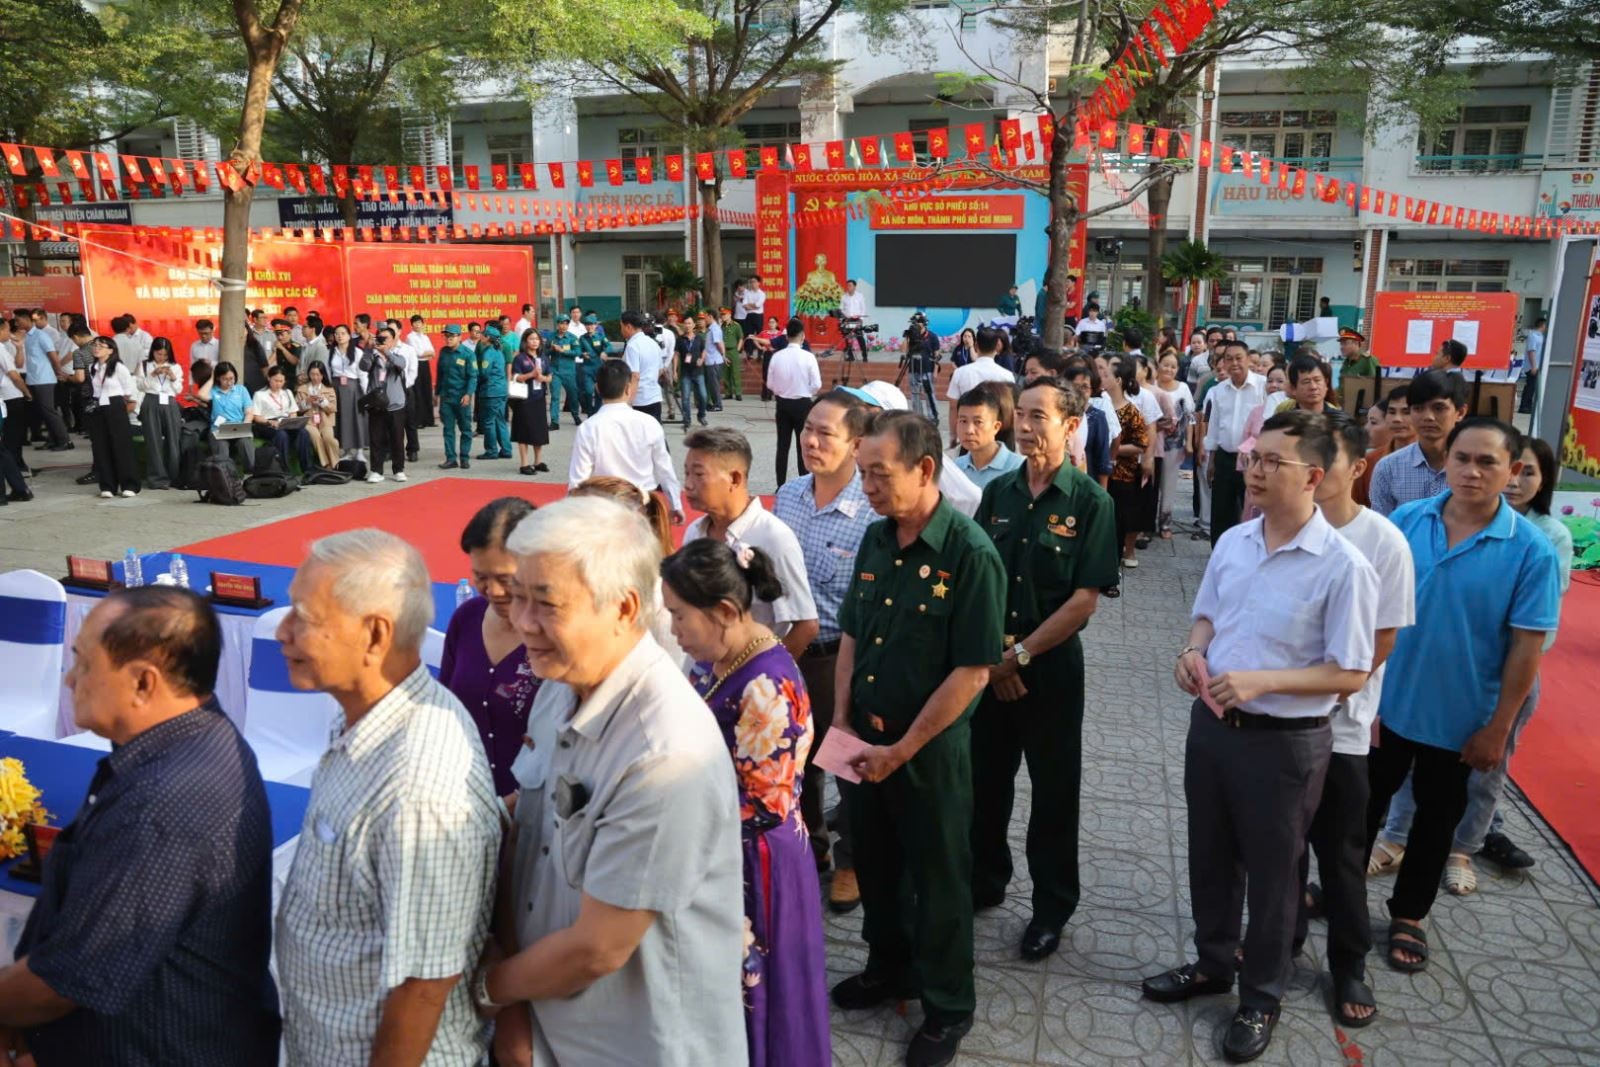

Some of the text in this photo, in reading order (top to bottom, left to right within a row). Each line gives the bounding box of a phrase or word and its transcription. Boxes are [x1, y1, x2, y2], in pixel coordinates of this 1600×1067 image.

[795, 172, 824, 182] NƯỚC
[826, 172, 855, 182] CỘNG
[859, 172, 881, 182] HÒA
[884, 172, 898, 182] XÃ
[1022, 169, 1044, 178] NAM
[588, 189, 675, 205] TIÊN HỌC LỄ
[1223, 184, 1261, 203] HẬU
[946, 200, 967, 211] PHIẾU
[928, 215, 950, 225] THÀNH
[952, 215, 966, 225] PHỐ
[279, 271, 291, 281] XVI
